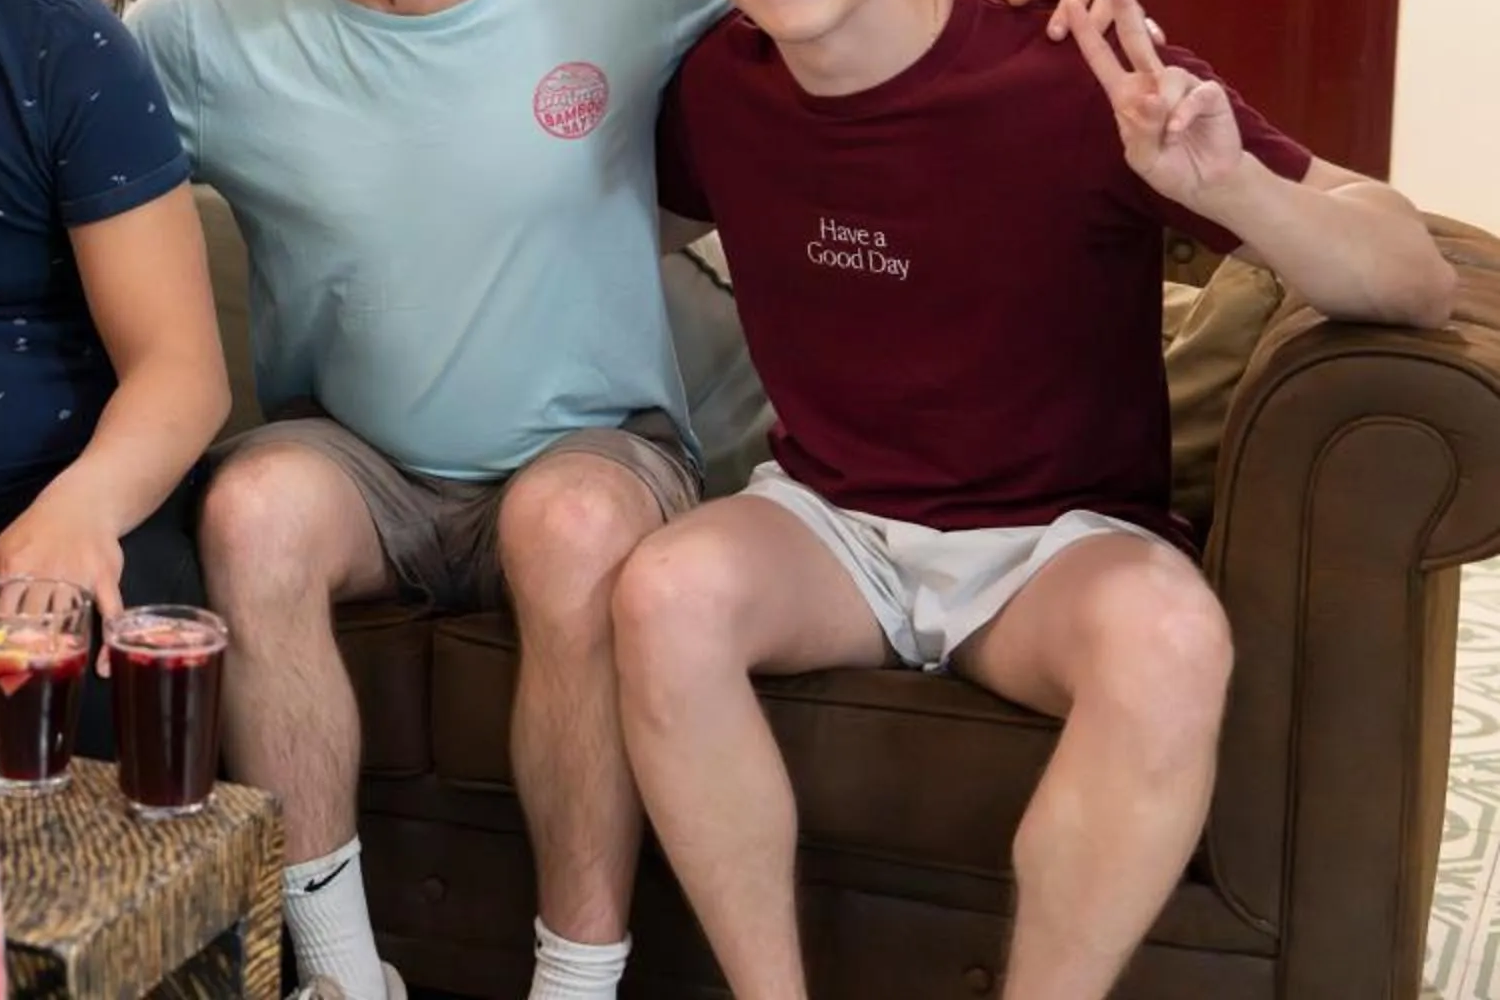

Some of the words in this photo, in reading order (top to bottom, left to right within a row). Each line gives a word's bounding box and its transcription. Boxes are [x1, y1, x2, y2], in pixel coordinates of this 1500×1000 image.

[820, 217, 869, 245] Have
[873, 231, 888, 247] a
[807, 241, 863, 269] Good
[868, 249, 910, 281] Day
